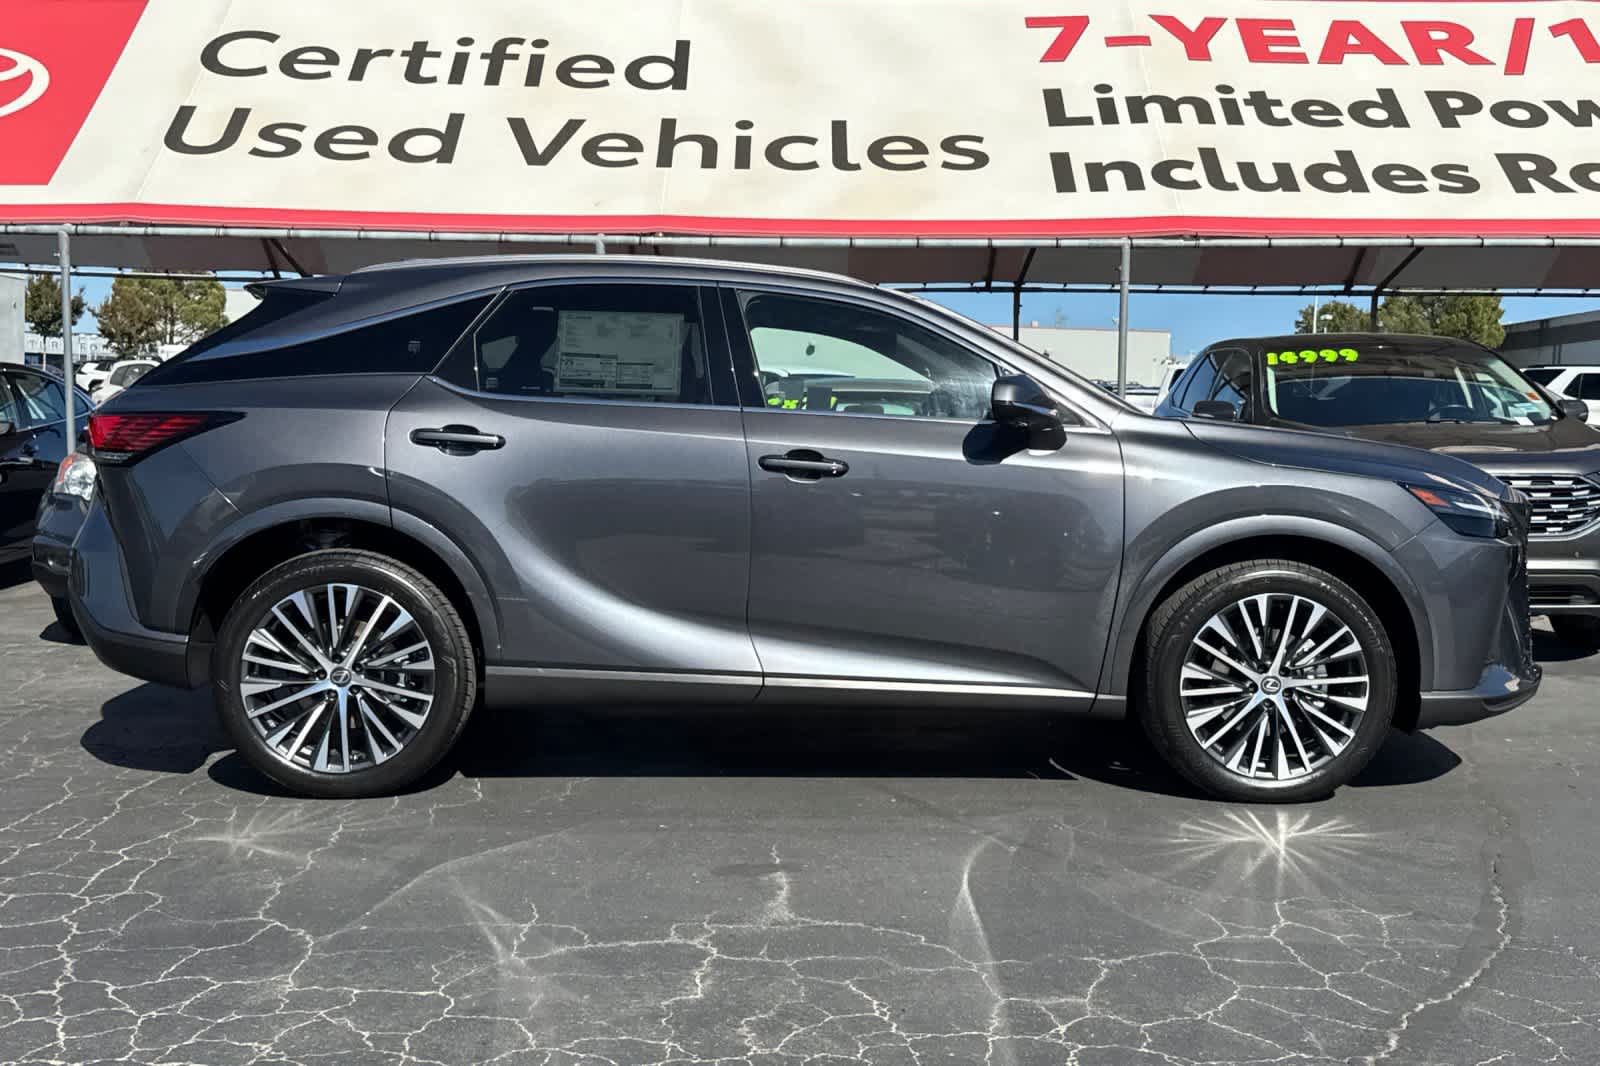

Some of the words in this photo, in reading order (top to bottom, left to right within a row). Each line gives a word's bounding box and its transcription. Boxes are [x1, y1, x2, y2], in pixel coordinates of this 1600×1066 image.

[200, 30, 692, 91] Certified
[1042, 83, 1411, 129] Limited
[163, 105, 465, 164] Used
[506, 117, 990, 171] Vehicles
[1049, 147, 1481, 194] Includes
